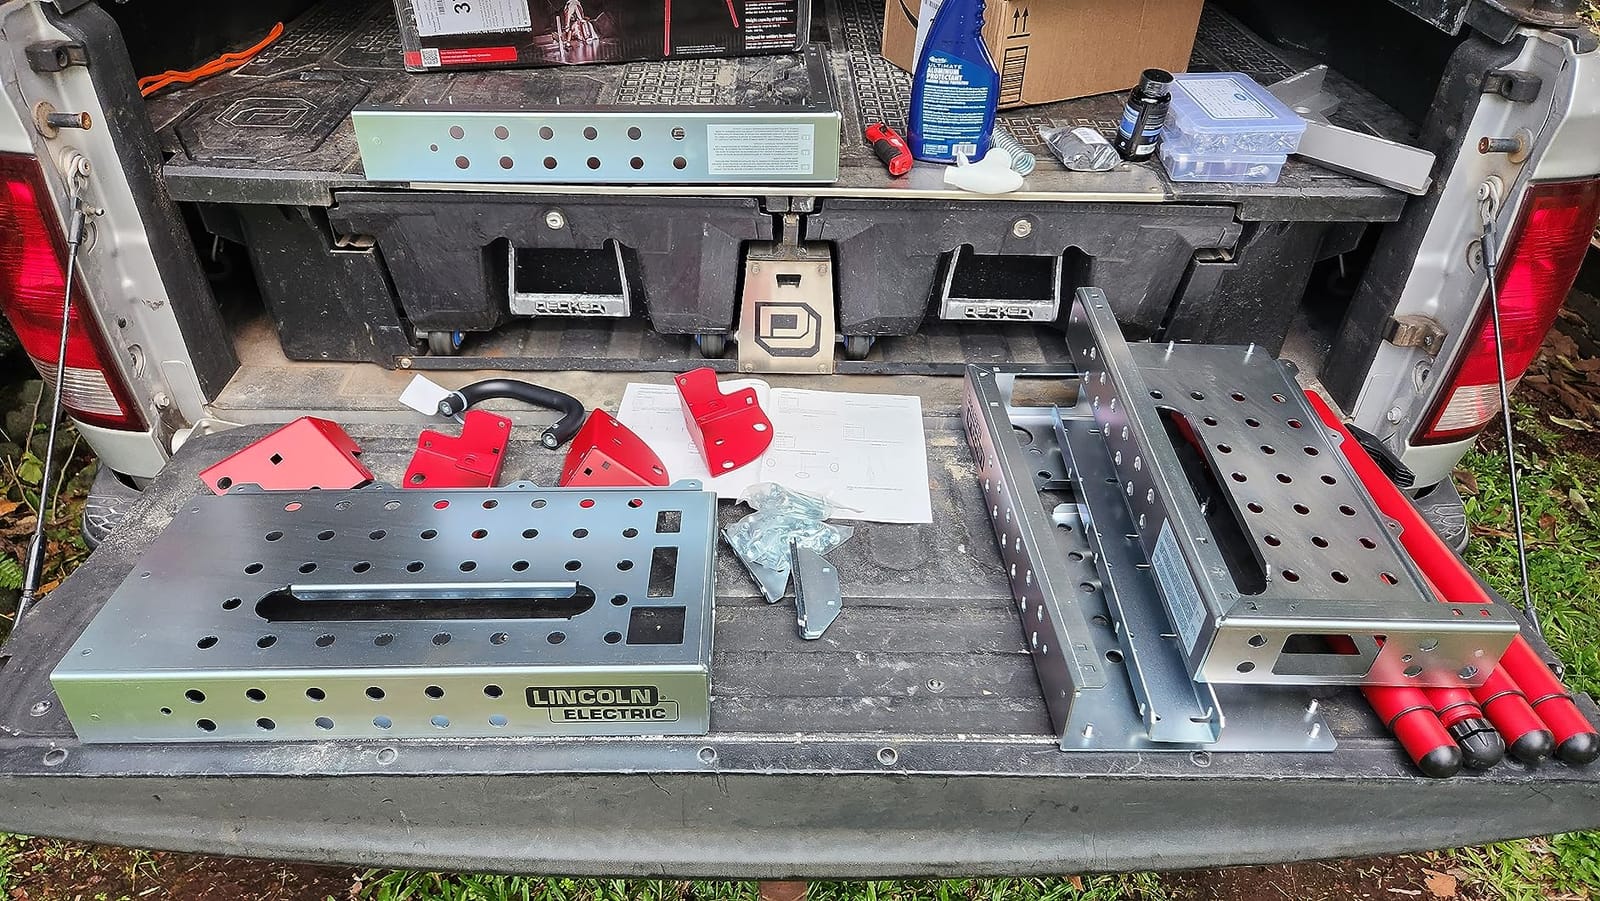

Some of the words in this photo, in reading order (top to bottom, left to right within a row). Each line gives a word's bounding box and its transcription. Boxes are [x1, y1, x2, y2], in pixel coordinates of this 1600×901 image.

[928, 62, 963, 70] ULTIMATE
[926, 73, 964, 81] PROTECTANT
[964, 305, 1034, 319] DECKED
[532, 688, 652, 705] LINCOLN
[563, 707, 667, 720] ELECTRIC
